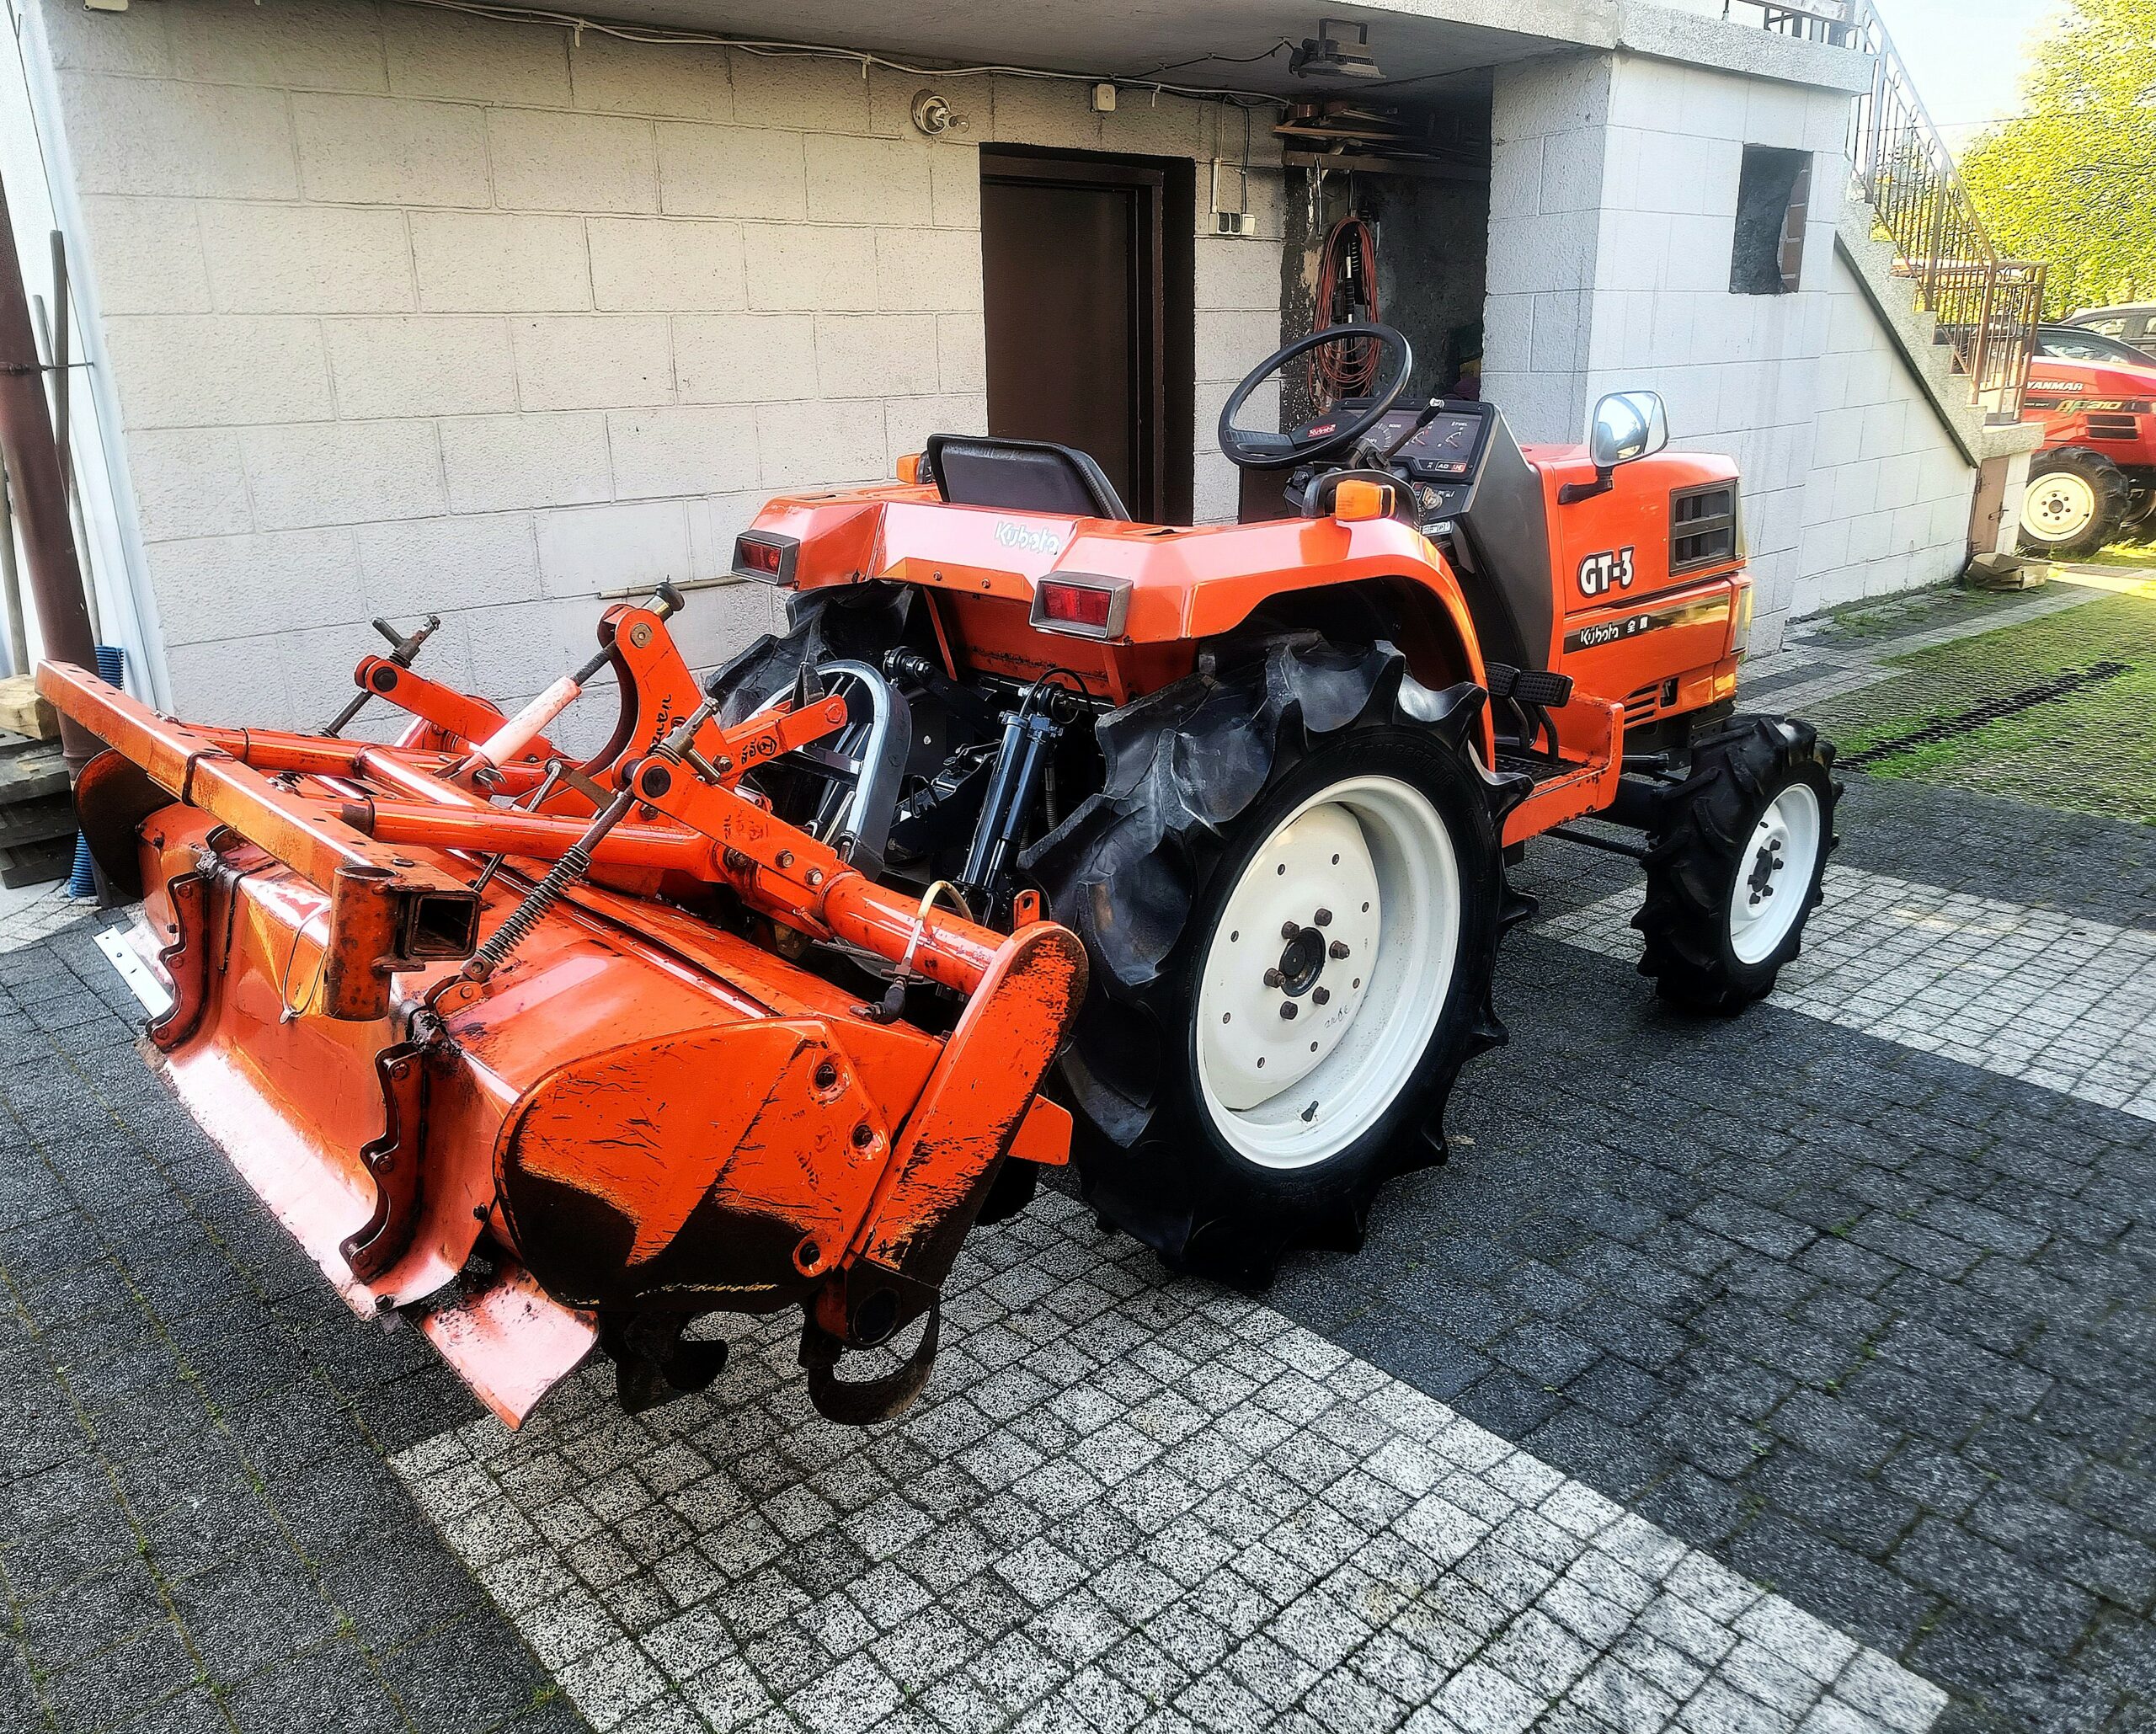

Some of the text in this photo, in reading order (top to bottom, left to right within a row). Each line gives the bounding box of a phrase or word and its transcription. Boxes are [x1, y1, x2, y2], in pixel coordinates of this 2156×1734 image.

[2026, 381, 2084, 391] YANMAR
[1309, 426, 1336, 436] Kubota
[995, 520, 1059, 554] Kubota
[1579, 547, 1634, 596] GT-3
[1580, 623, 1619, 645] Kubota
